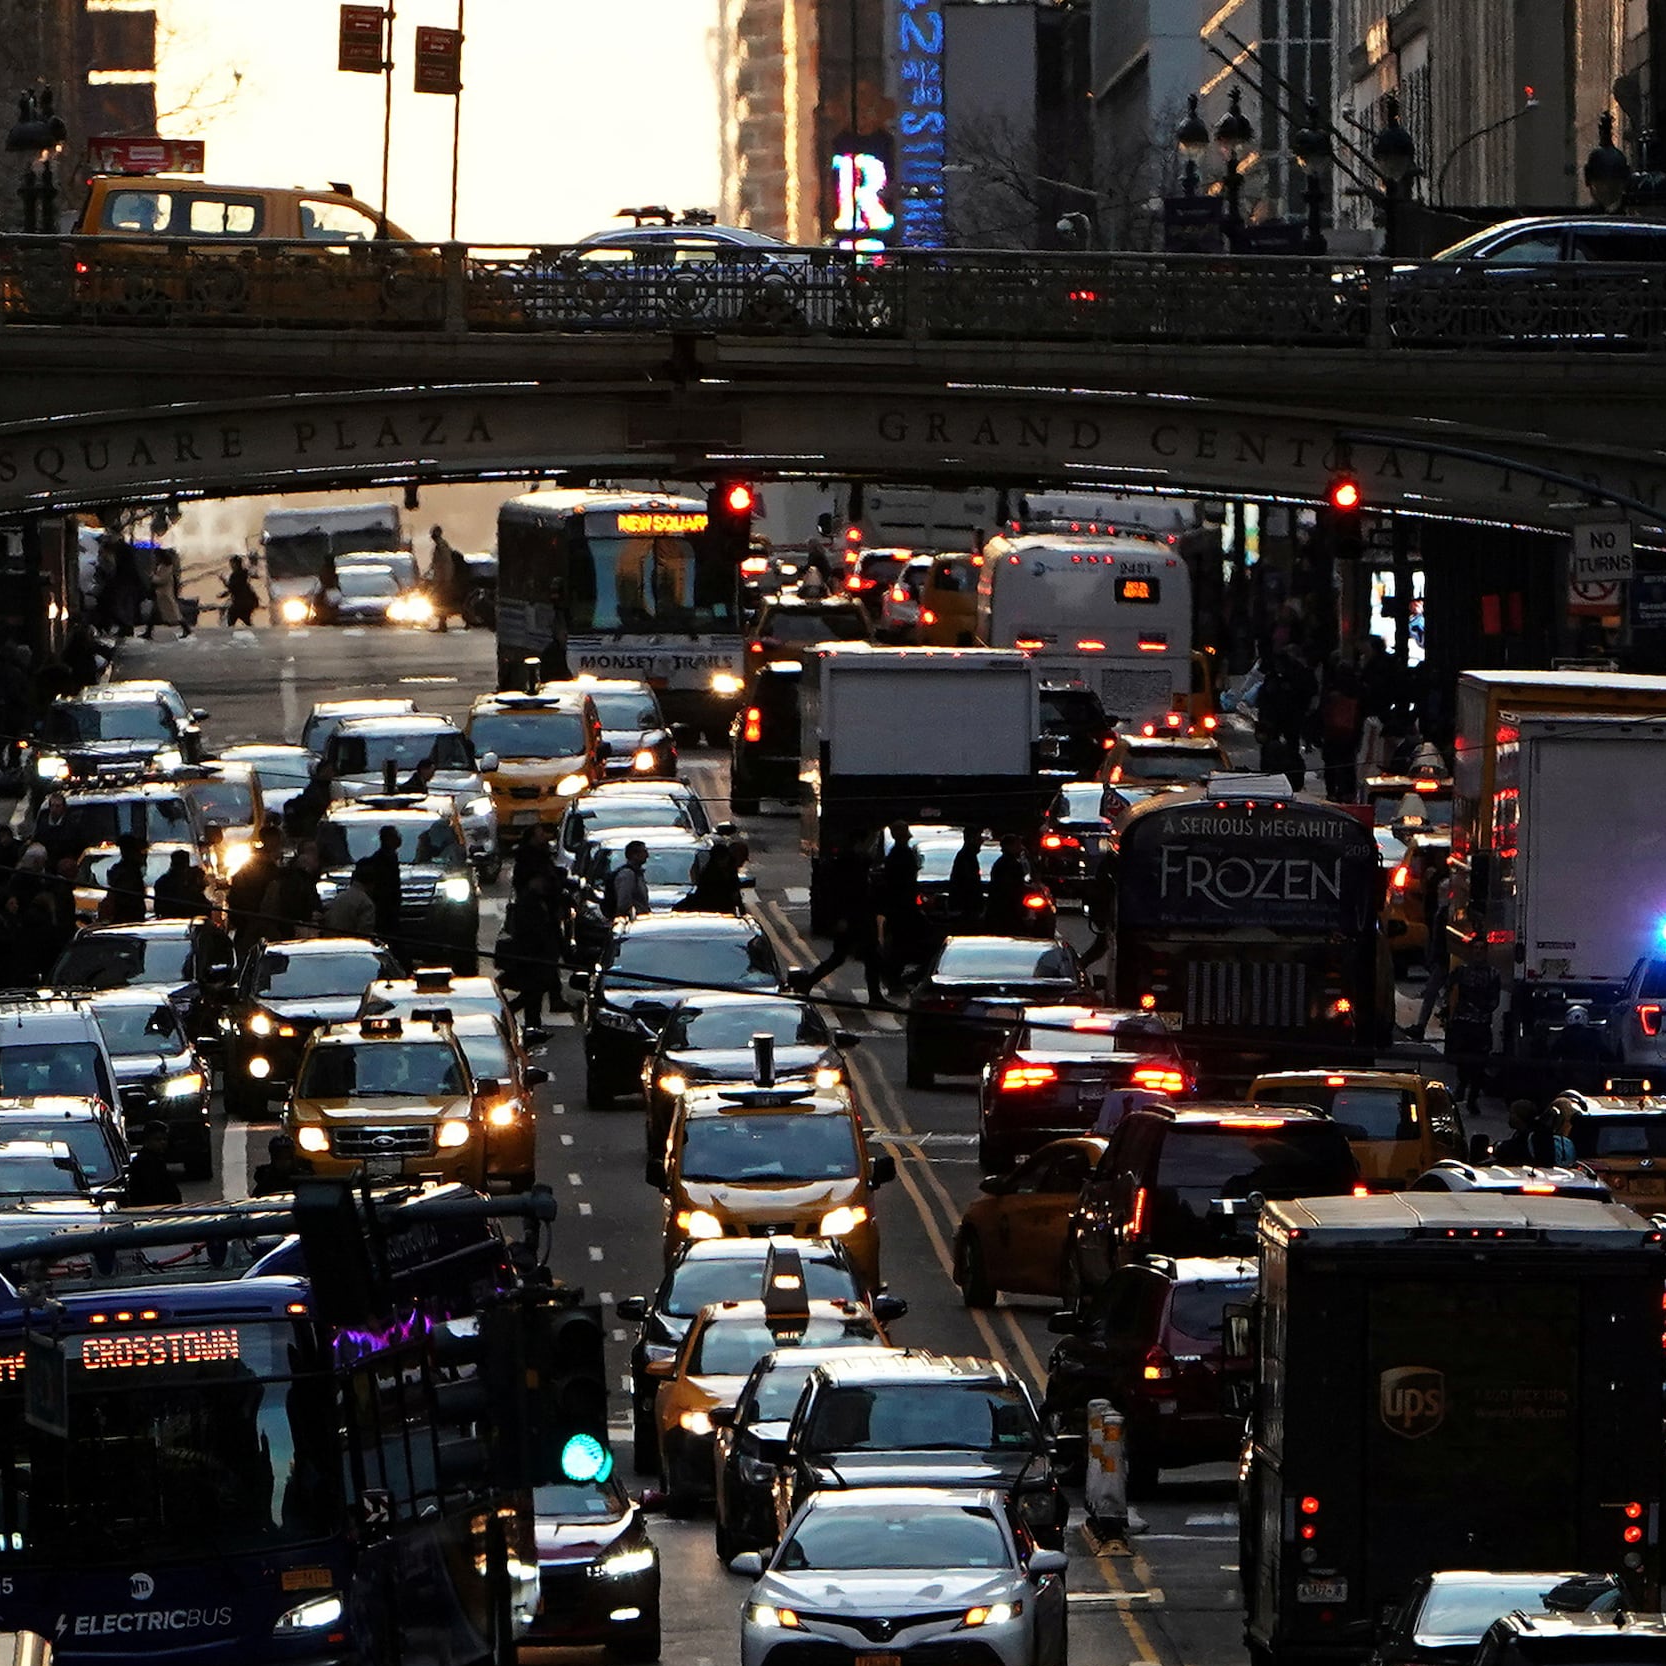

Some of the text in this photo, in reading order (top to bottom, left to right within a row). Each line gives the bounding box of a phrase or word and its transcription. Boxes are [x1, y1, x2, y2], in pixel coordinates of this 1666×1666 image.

[293, 415, 494, 455] PLAZA
[878, 412, 1101, 451] GRAND
[1151, 424, 1445, 484] CENTAL
[653, 513, 709, 533] SQUAR
[1590, 532, 1615, 549] NO
[1579, 556, 1632, 574] TURNS
[579, 655, 655, 670] MONSEY
[1162, 816, 1345, 839] A SERIOUS MEGAHIT!
[1343, 843, 1371, 858] 209
[1159, 845, 1342, 910] FROZEN
[82, 1330, 241, 1371] CROSSTOWN
[1386, 1388, 1440, 1428] ups
